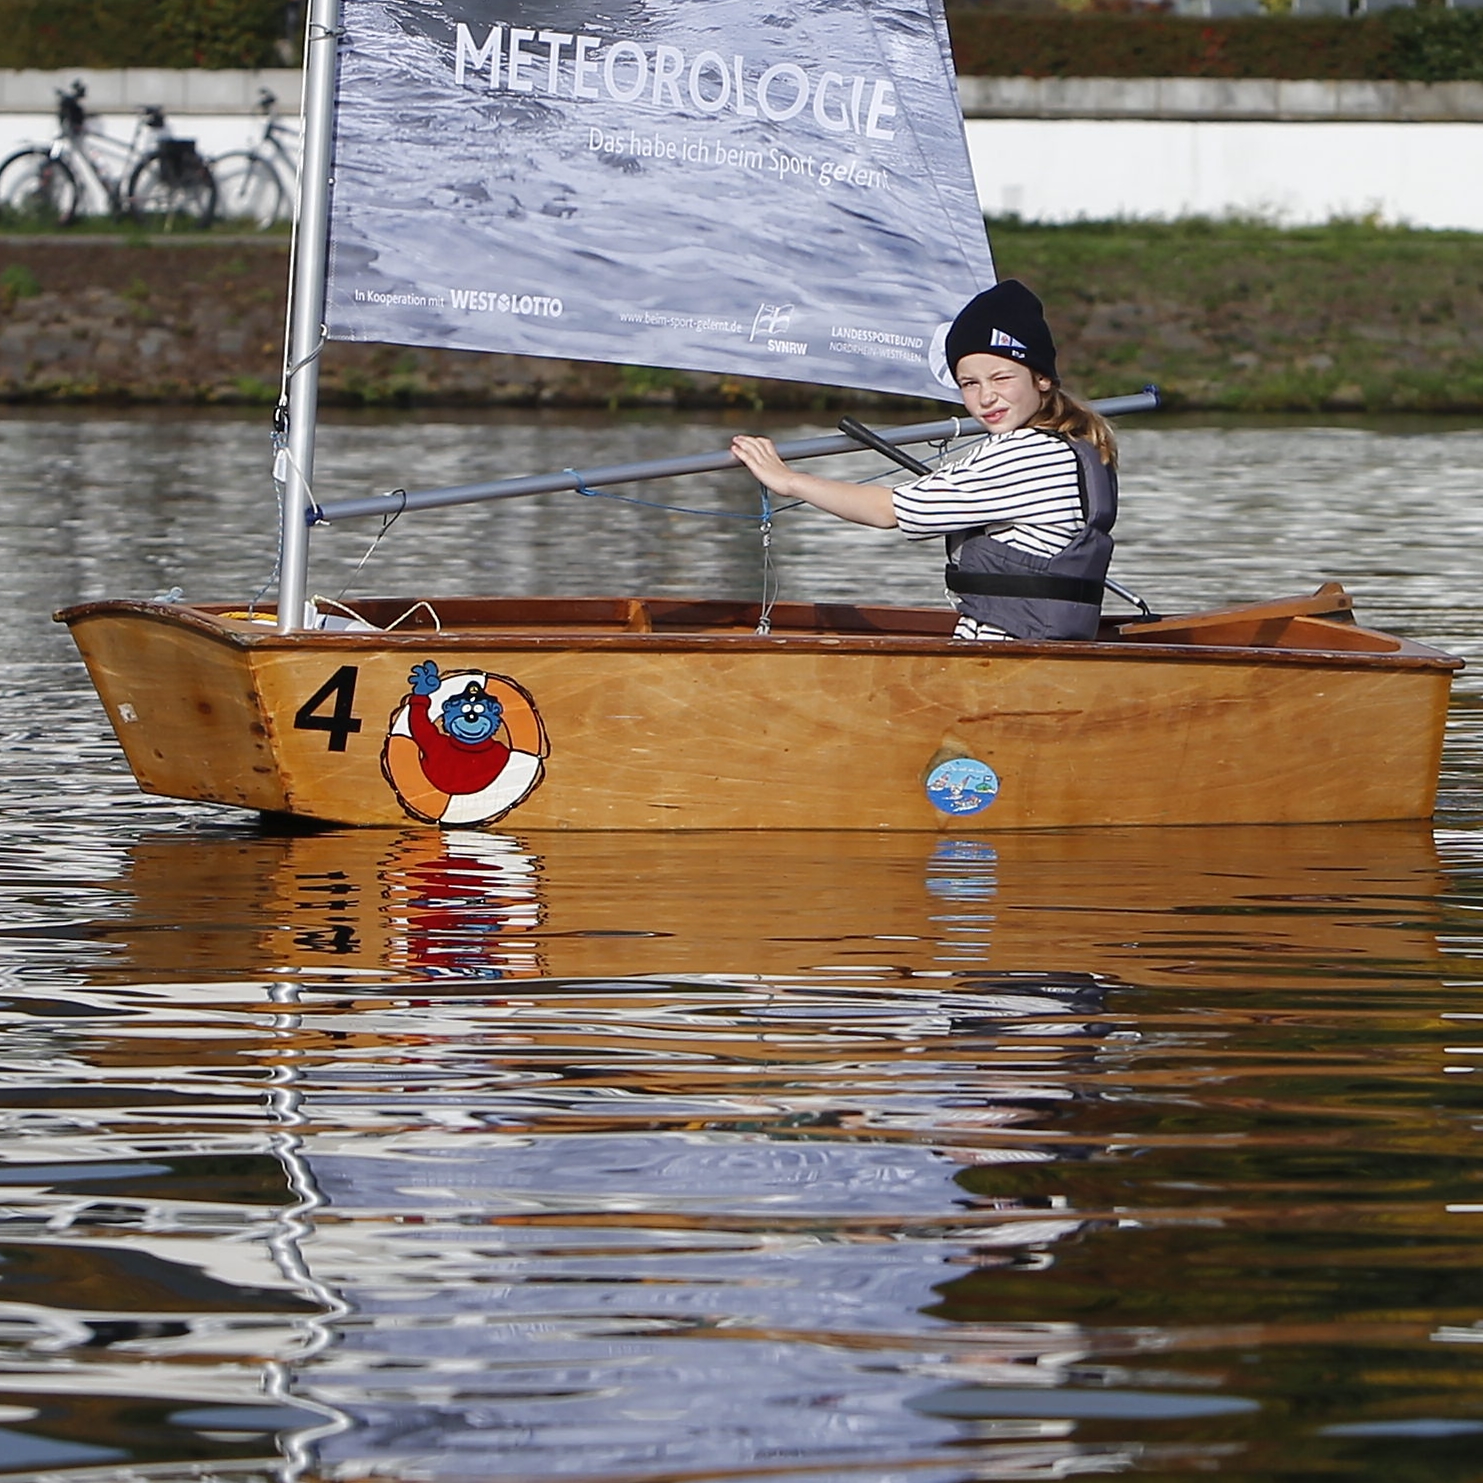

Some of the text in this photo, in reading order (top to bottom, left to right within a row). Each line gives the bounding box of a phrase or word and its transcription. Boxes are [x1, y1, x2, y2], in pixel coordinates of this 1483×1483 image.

[454, 21, 897, 141] METEOROLOGIE
[589, 126, 892, 191] Das habe ich beim Sport gelernt
[355, 288, 445, 309] In Kooperation mit
[619, 310, 743, 334] www.beim-sport-gelernt.de
[767, 338, 809, 356] SVNRW
[831, 325, 924, 349] LANDESSPORTBUND
[828, 340, 923, 363] NORDRHEIN-WESTFALEN
[293, 664, 363, 753] 4
